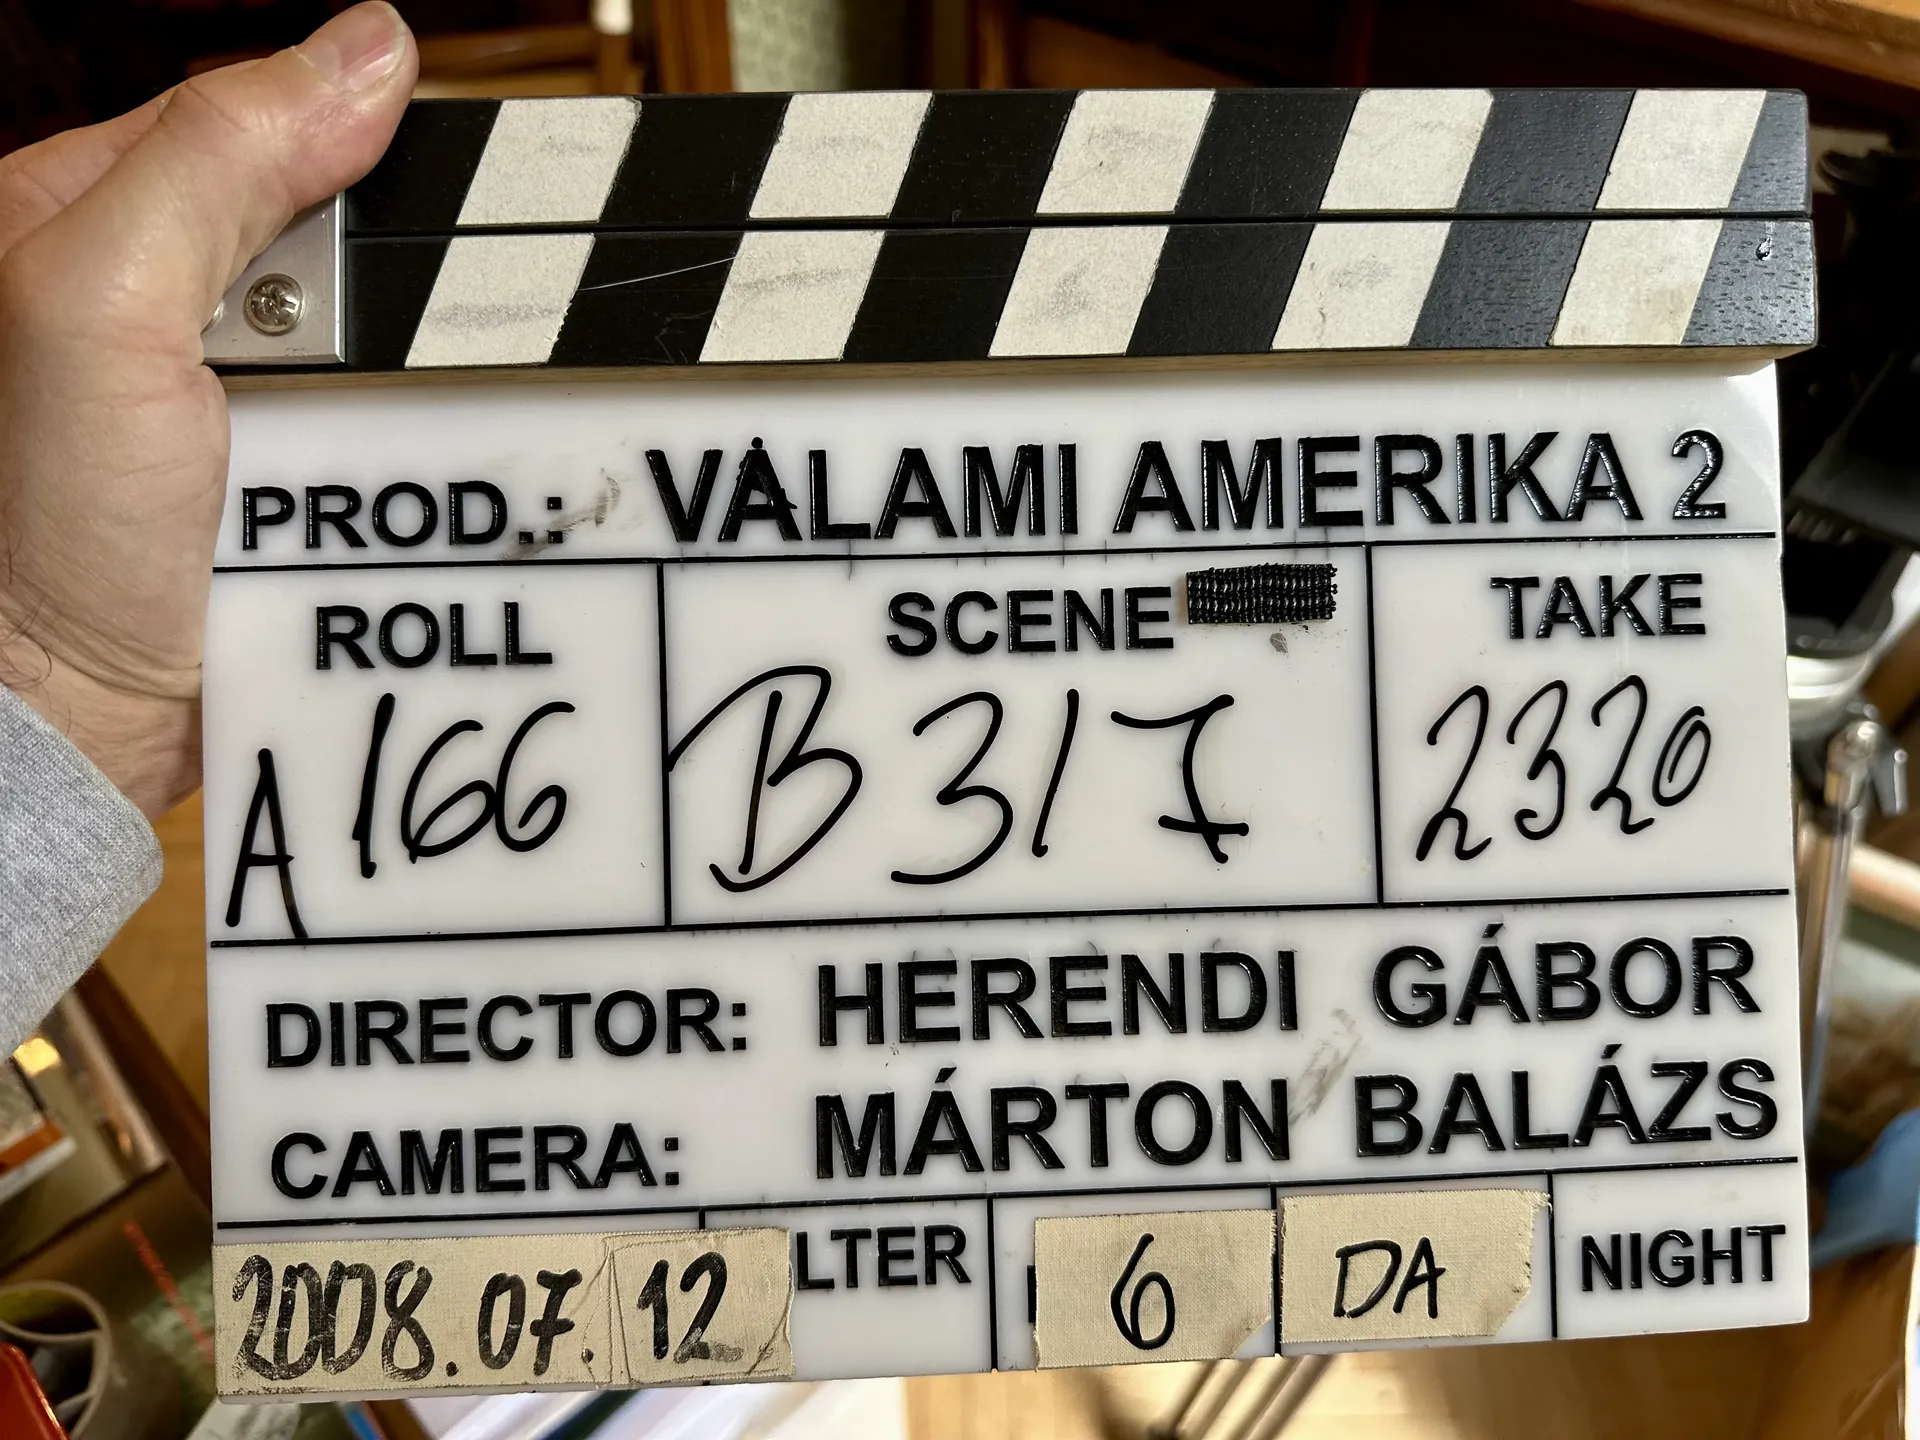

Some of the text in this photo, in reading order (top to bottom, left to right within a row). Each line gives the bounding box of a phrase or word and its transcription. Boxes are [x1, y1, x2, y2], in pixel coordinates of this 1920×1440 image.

[241, 480, 563, 552] PROD.:
[1111, 430, 1644, 534] AMERIKA
[1671, 429, 1727, 520] 2
[316, 601, 553, 670] ROLL
[886, 586, 1175, 656] SCENE
[1490, 572, 1707, 640] TAKE
[353, 693, 576, 879] 166
[266, 923, 1761, 1069] DIRECTOR: HERENDI GÁBOR
[271, 1043, 1779, 1199] CAMERA: MÁRTON BALÁZS
[797, 1224, 973, 1290] LTER
[1110, 1233, 1175, 1350] 6
[1333, 1236, 1446, 1320] DA
[1580, 1224, 1788, 1293] NIGHT
